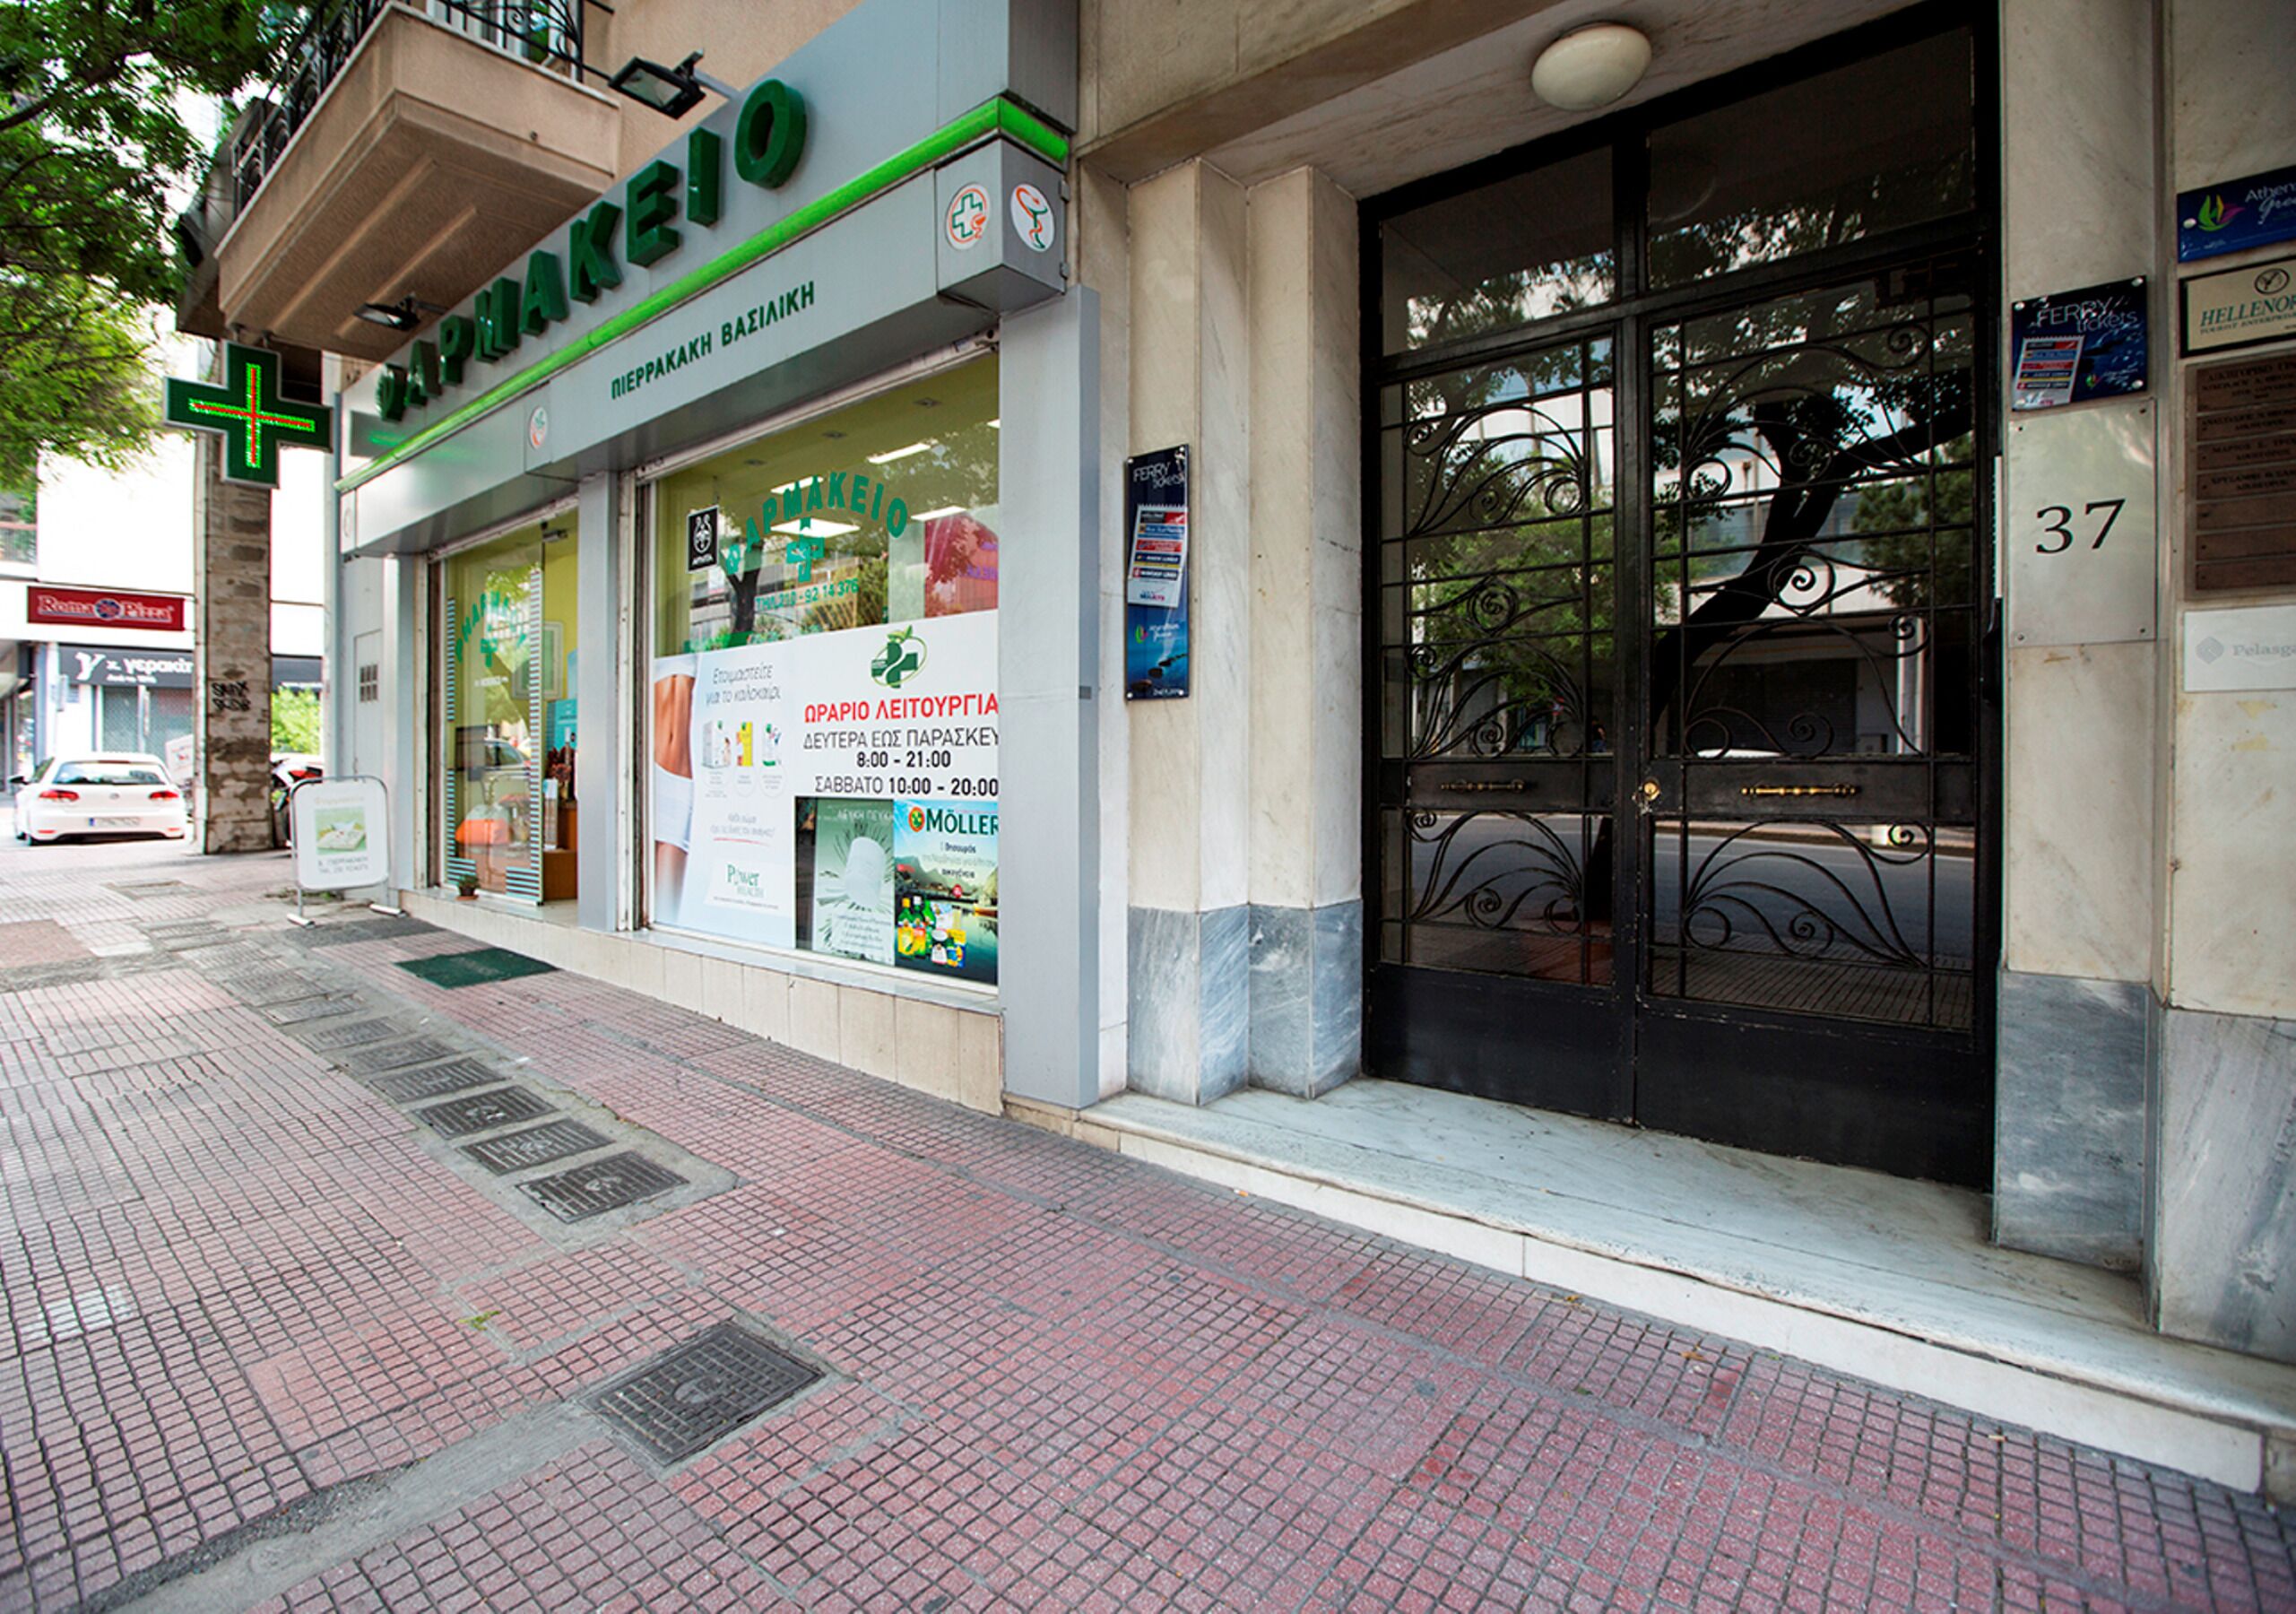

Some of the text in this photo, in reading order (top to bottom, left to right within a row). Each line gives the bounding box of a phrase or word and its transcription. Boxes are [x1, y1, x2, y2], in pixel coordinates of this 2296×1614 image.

[377, 79, 807, 421] ΦΑΡΜΑΚΕΙΟ
[2036, 295, 2113, 328] FERRY
[611, 280, 816, 400] ΠΙΕΡΡΑΚΑΚΗ ΒΑΣΙΛΙΚΗ
[1133, 462, 1171, 482] FERRY
[725, 472, 907, 575] ΦΑΡΜΑΚΕΙΟ
[2036, 499, 2126, 553] 37
[804, 693, 998, 724] ΩΡΑΡΙΟ ΛΕΙΤΟΥΡΓΙΑ
[803, 726, 998, 750] ΔΕΥΤΕΡΑ ΕΩΣ ΠΑΡΑΣΚΕΥ
[857, 751, 888, 768] 8:00
[906, 751, 951, 768] 21:00
[815, 777, 882, 794] ΣΑΒΒΑΤΟ
[888, 777, 931, 794] 10:00
[950, 778, 998, 796] 20:00
